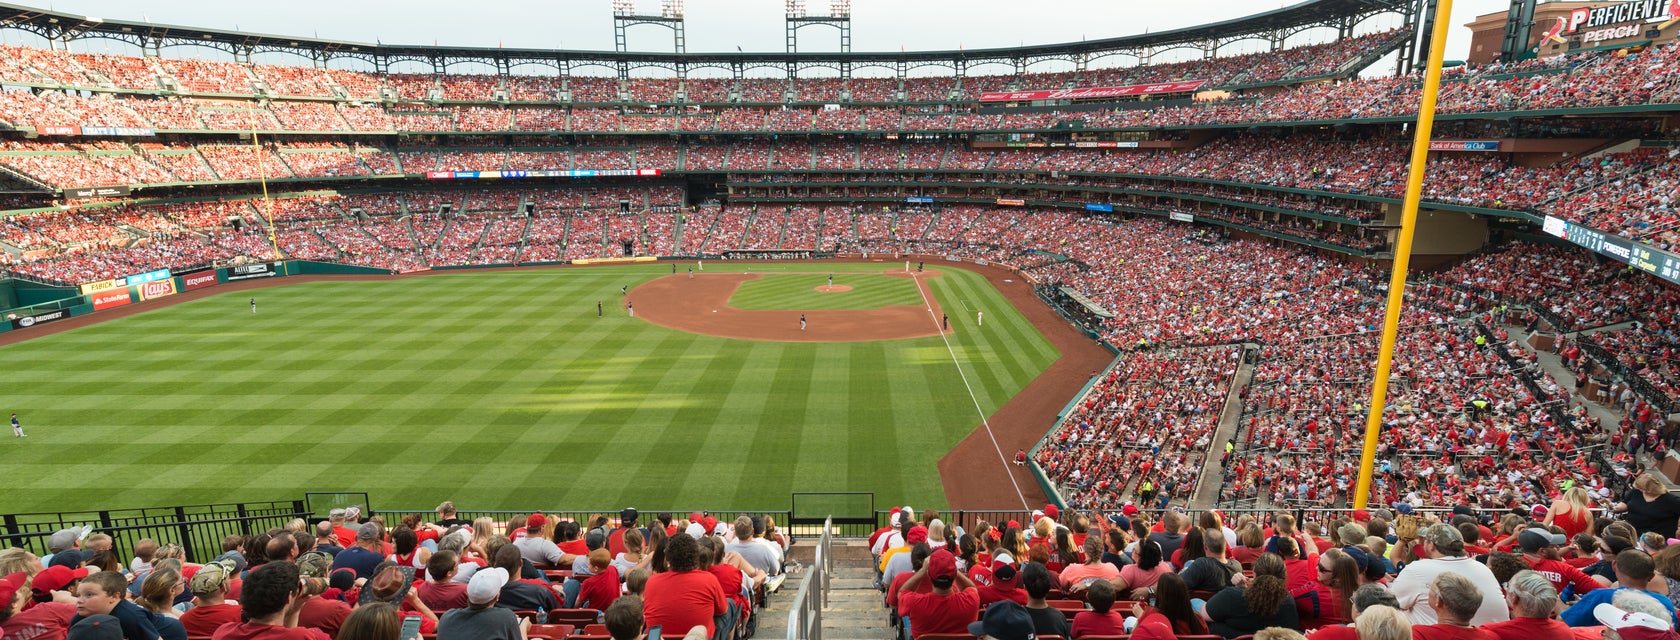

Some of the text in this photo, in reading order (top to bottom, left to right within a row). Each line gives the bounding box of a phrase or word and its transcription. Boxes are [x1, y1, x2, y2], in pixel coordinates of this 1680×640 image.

[1584, 24, 1640, 43] PERCH
[1048, 86, 1135, 99] Budweiser
[56, 126, 74, 135] MPH
[1585, 235, 1590, 247] 1
[1590, 237, 1596, 249] 2
[1602, 241, 1631, 259] POWERADE
[91, 281, 113, 291] FABICK
[186, 275, 215, 286] EQUIFAX
[35, 311, 63, 323] MIDWEST
